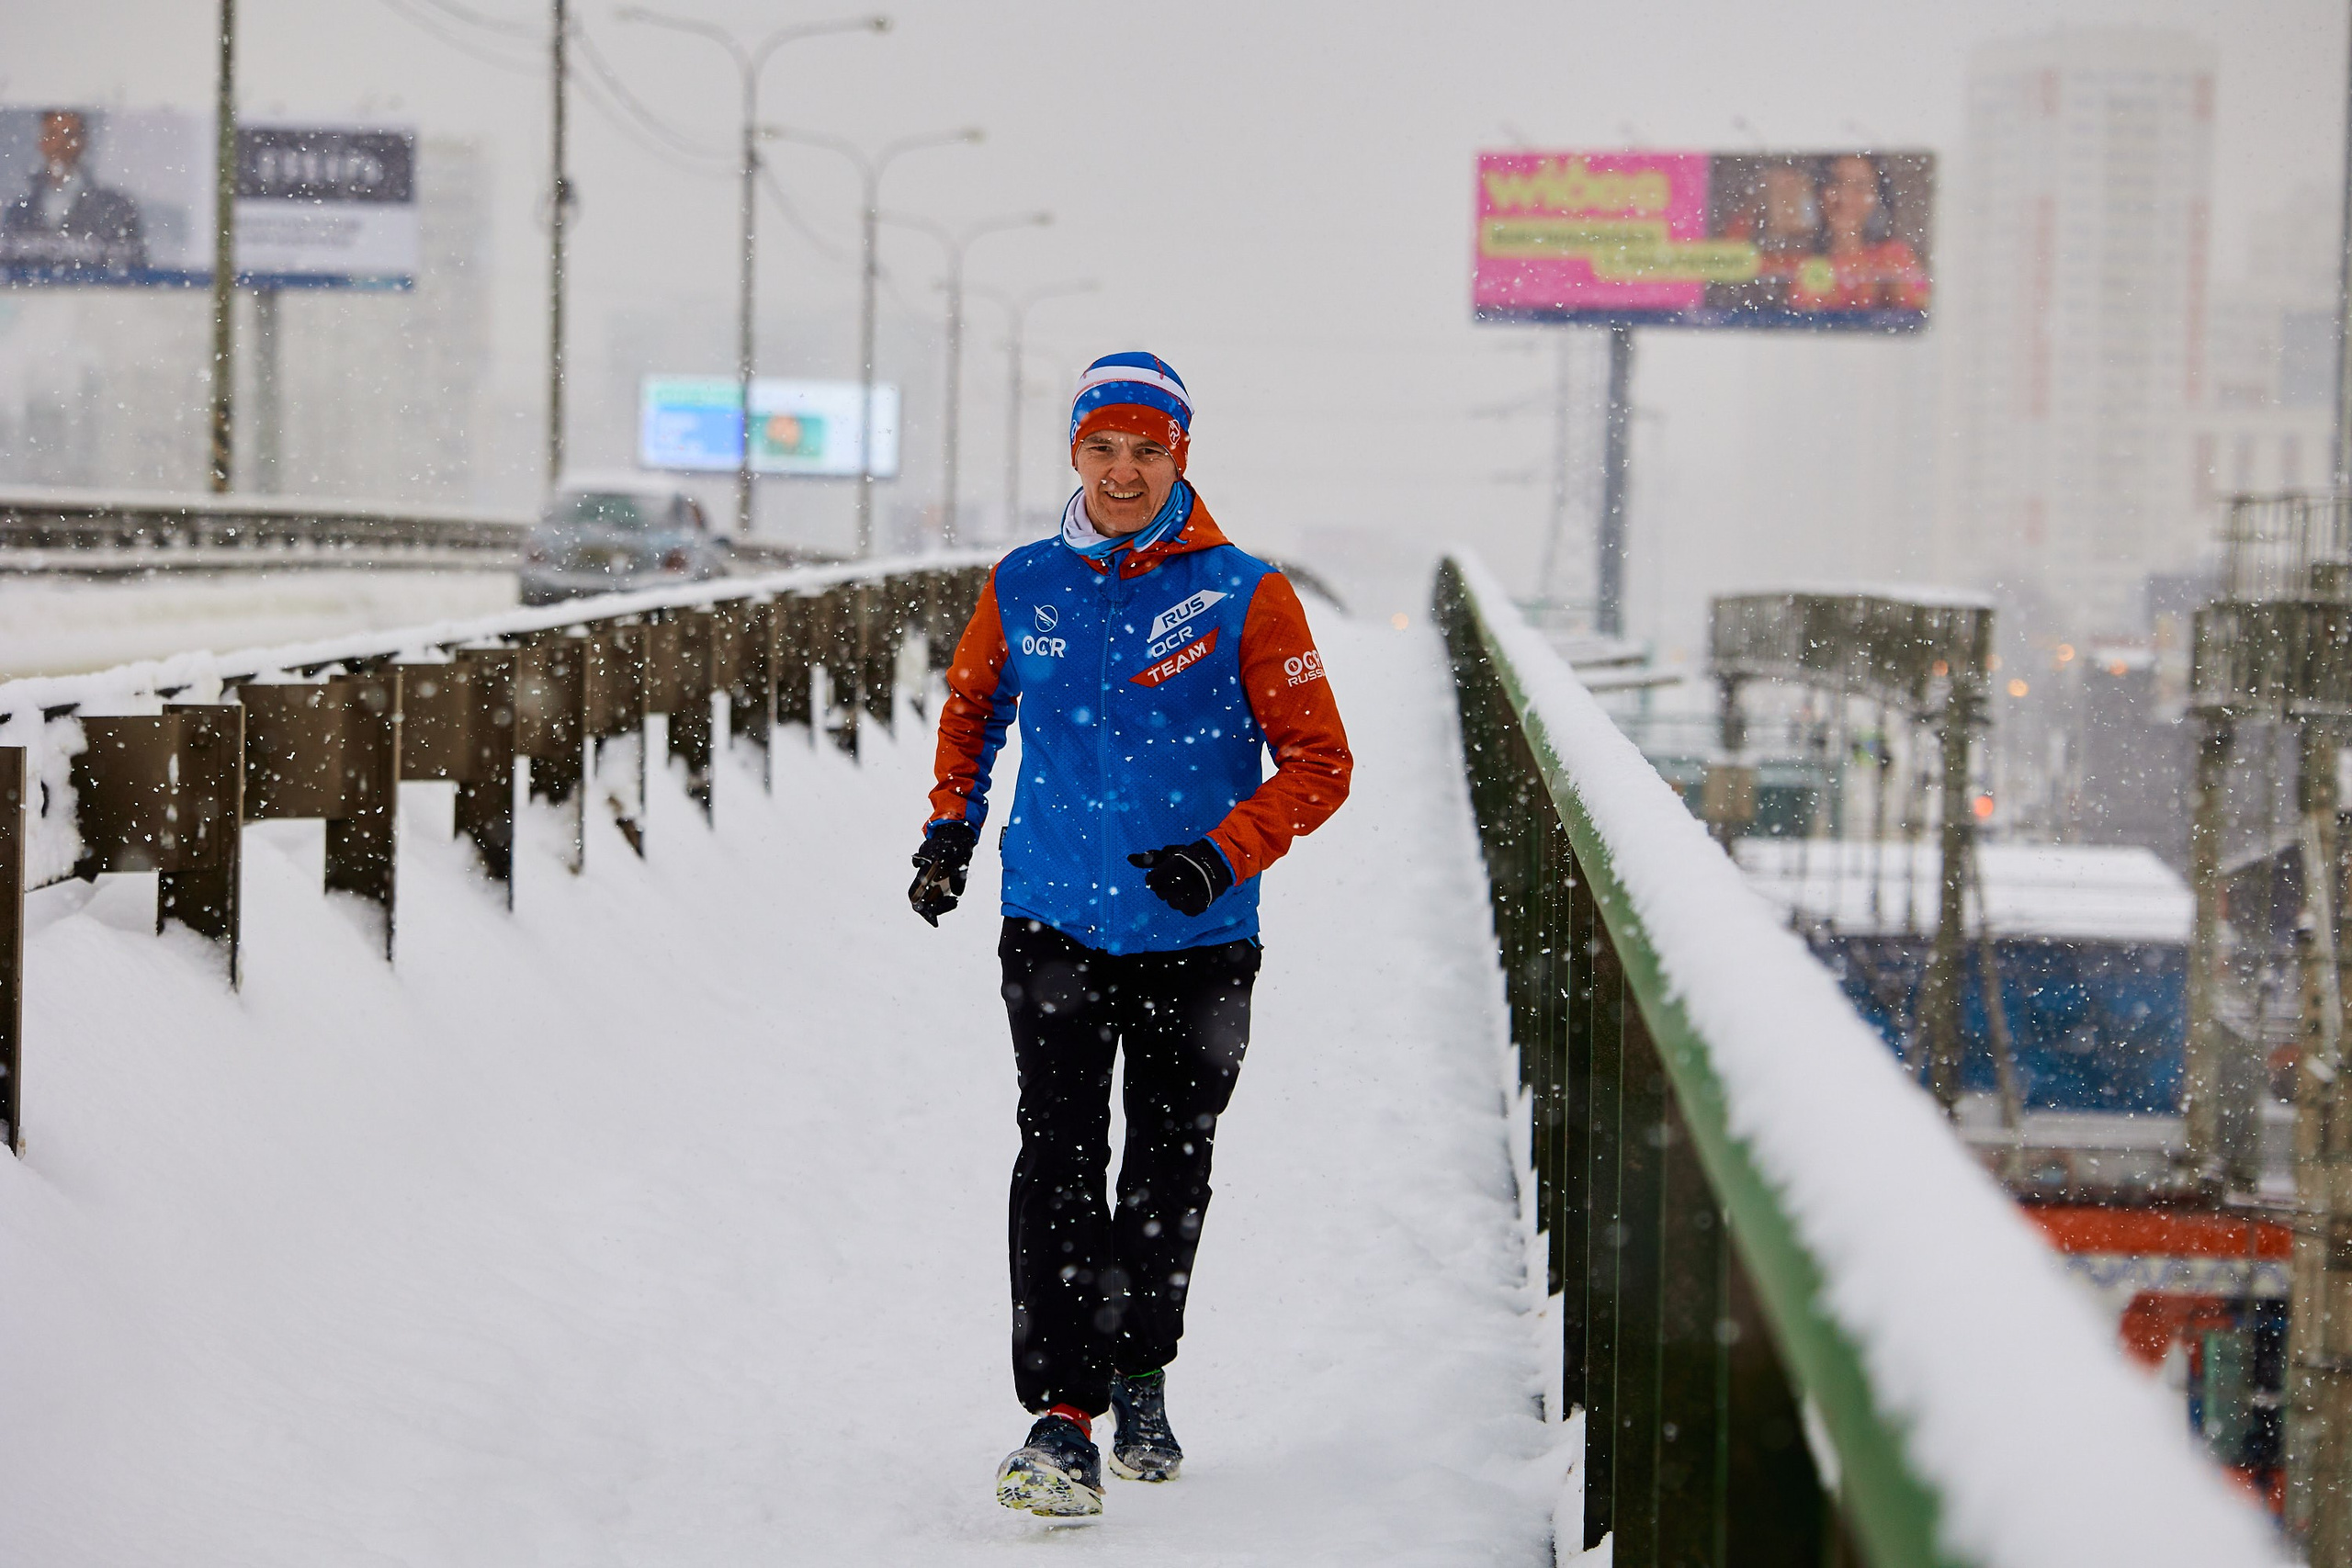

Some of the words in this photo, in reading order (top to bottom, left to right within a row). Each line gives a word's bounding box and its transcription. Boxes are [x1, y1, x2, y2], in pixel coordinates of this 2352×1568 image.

[1162, 597, 1204, 628] RUS
[1023, 635, 1066, 658] OCR
[1150, 626, 1194, 658] OCR
[1148, 642, 1207, 682] TEAM
